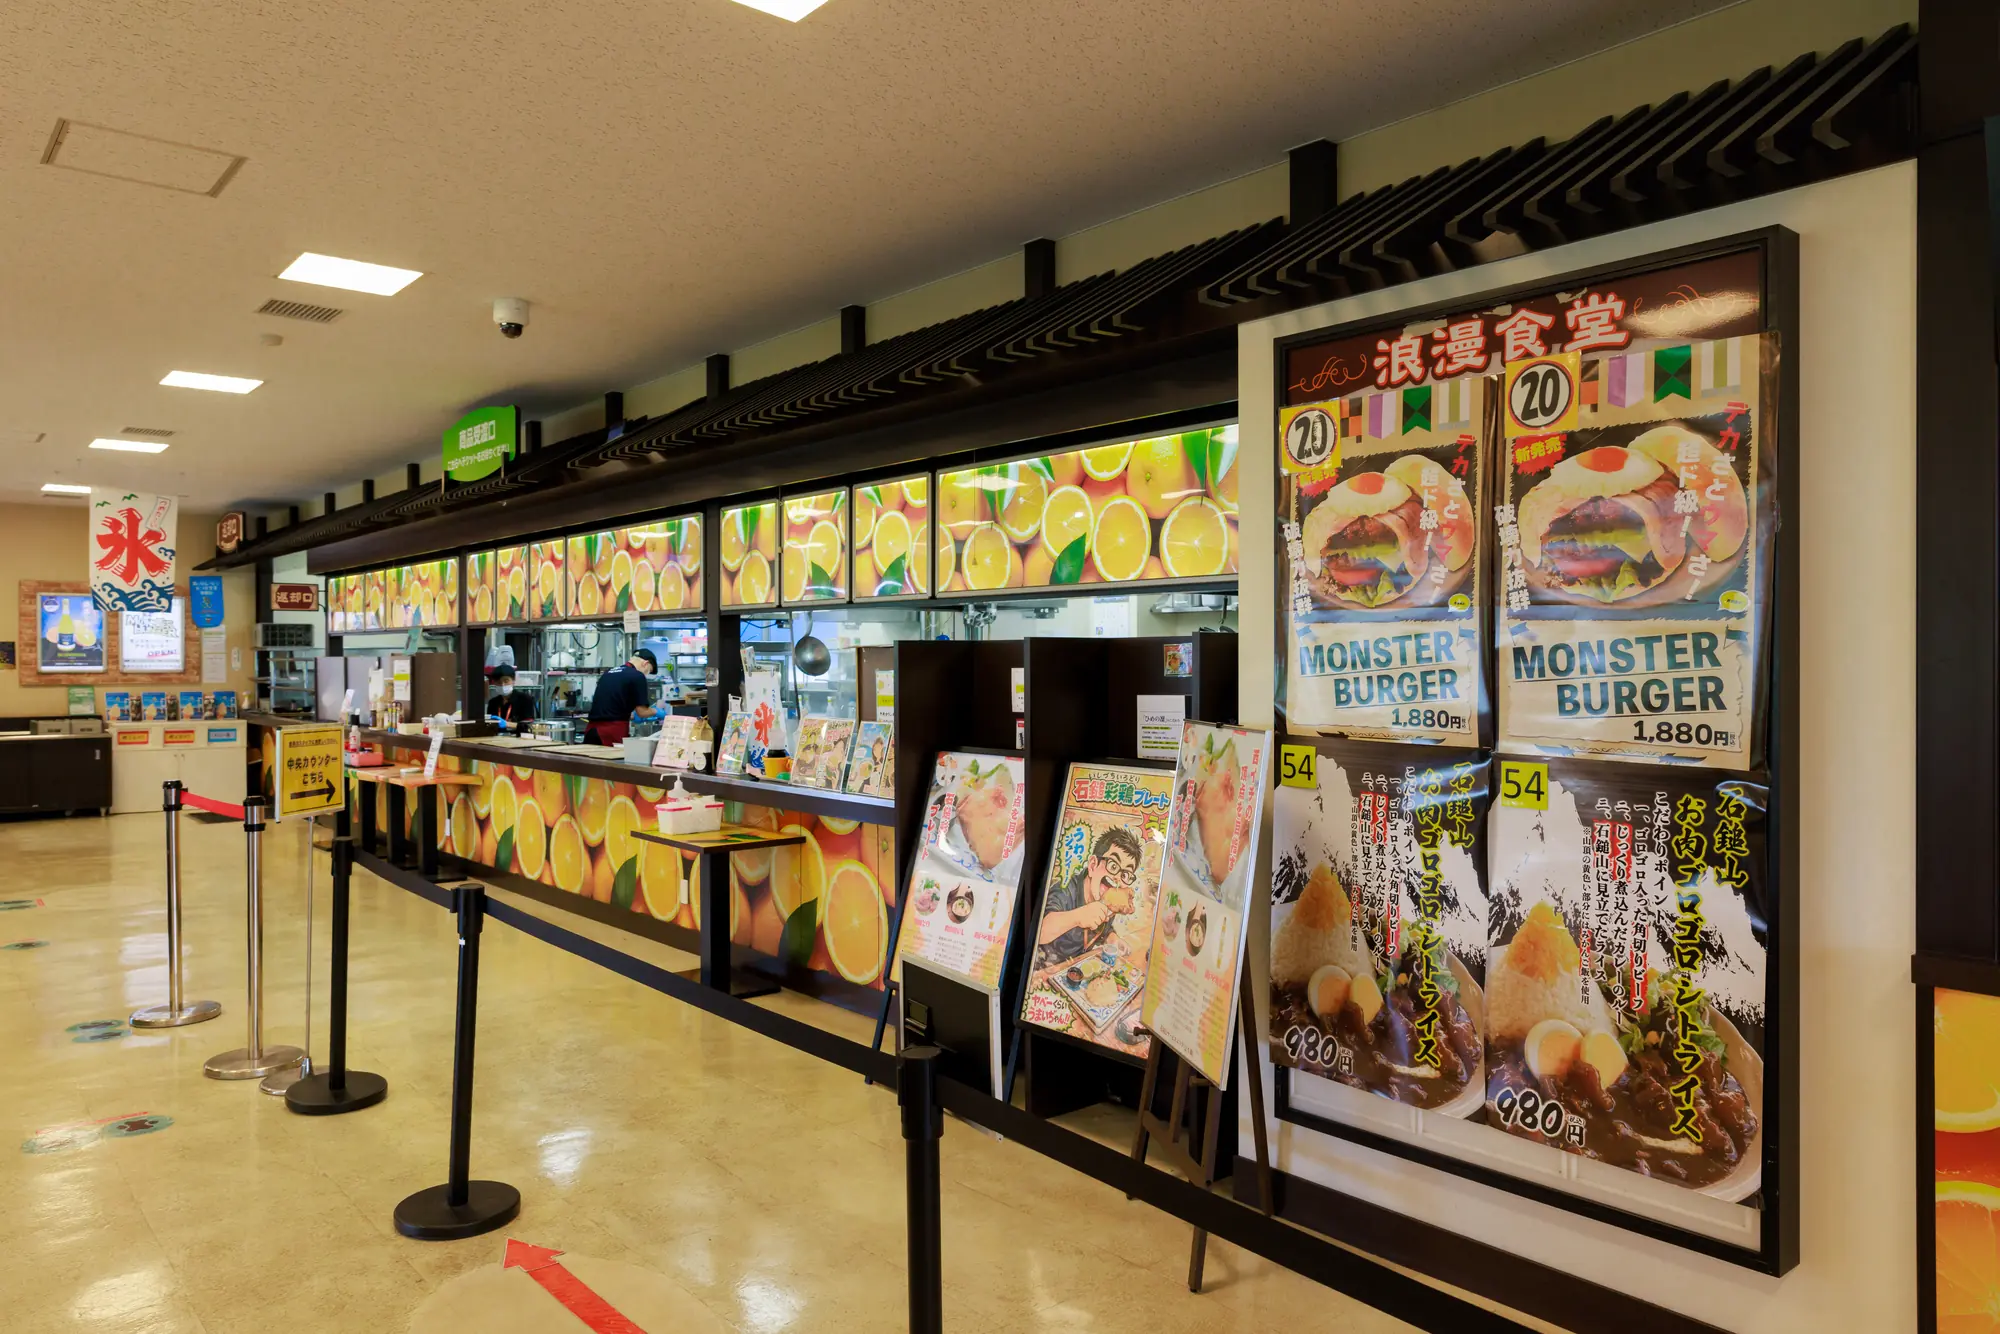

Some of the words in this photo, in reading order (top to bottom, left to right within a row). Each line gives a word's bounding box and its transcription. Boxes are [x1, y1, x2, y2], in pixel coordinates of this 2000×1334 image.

[1373, 292, 1628, 386] 浪漫食堂
[1521, 368, 1560, 421] 20
[1295, 414, 1328, 460] 20
[1515, 437, 1562, 464] 新発売
[95, 507, 171, 587] 氷
[1282, 522, 1313, 617] 破壊力抜群
[1494, 503, 1531, 612] 破壊力抜群
[276, 592, 312, 603] 返却口
[1300, 631, 1456, 675] MONSTER
[1513, 632, 1722, 679] MONSTER
[1333, 669, 1460, 707] BURGER
[1556, 675, 1728, 717] BURGER
[1392, 708, 1461, 729] 1,880円
[1633, 720, 1729, 746] 1,880円
[287, 754, 338, 770] 中央カウンター
[302, 771, 324, 786] こちら
[1283, 752, 1313, 781] 54
[1503, 768, 1545, 802] 54
[1402, 766, 1416, 881] こだわりポイント
[1446, 762, 1475, 848] 石鎚山
[1652, 792, 1670, 925] こだわりポイント
[1713, 787, 1750, 888] 石鎚山
[1594, 798, 1612, 982] 三、石鎚山に見立てたライス
[1612, 800, 1631, 1025] 二、じっくり煮込んだカレーのルー
